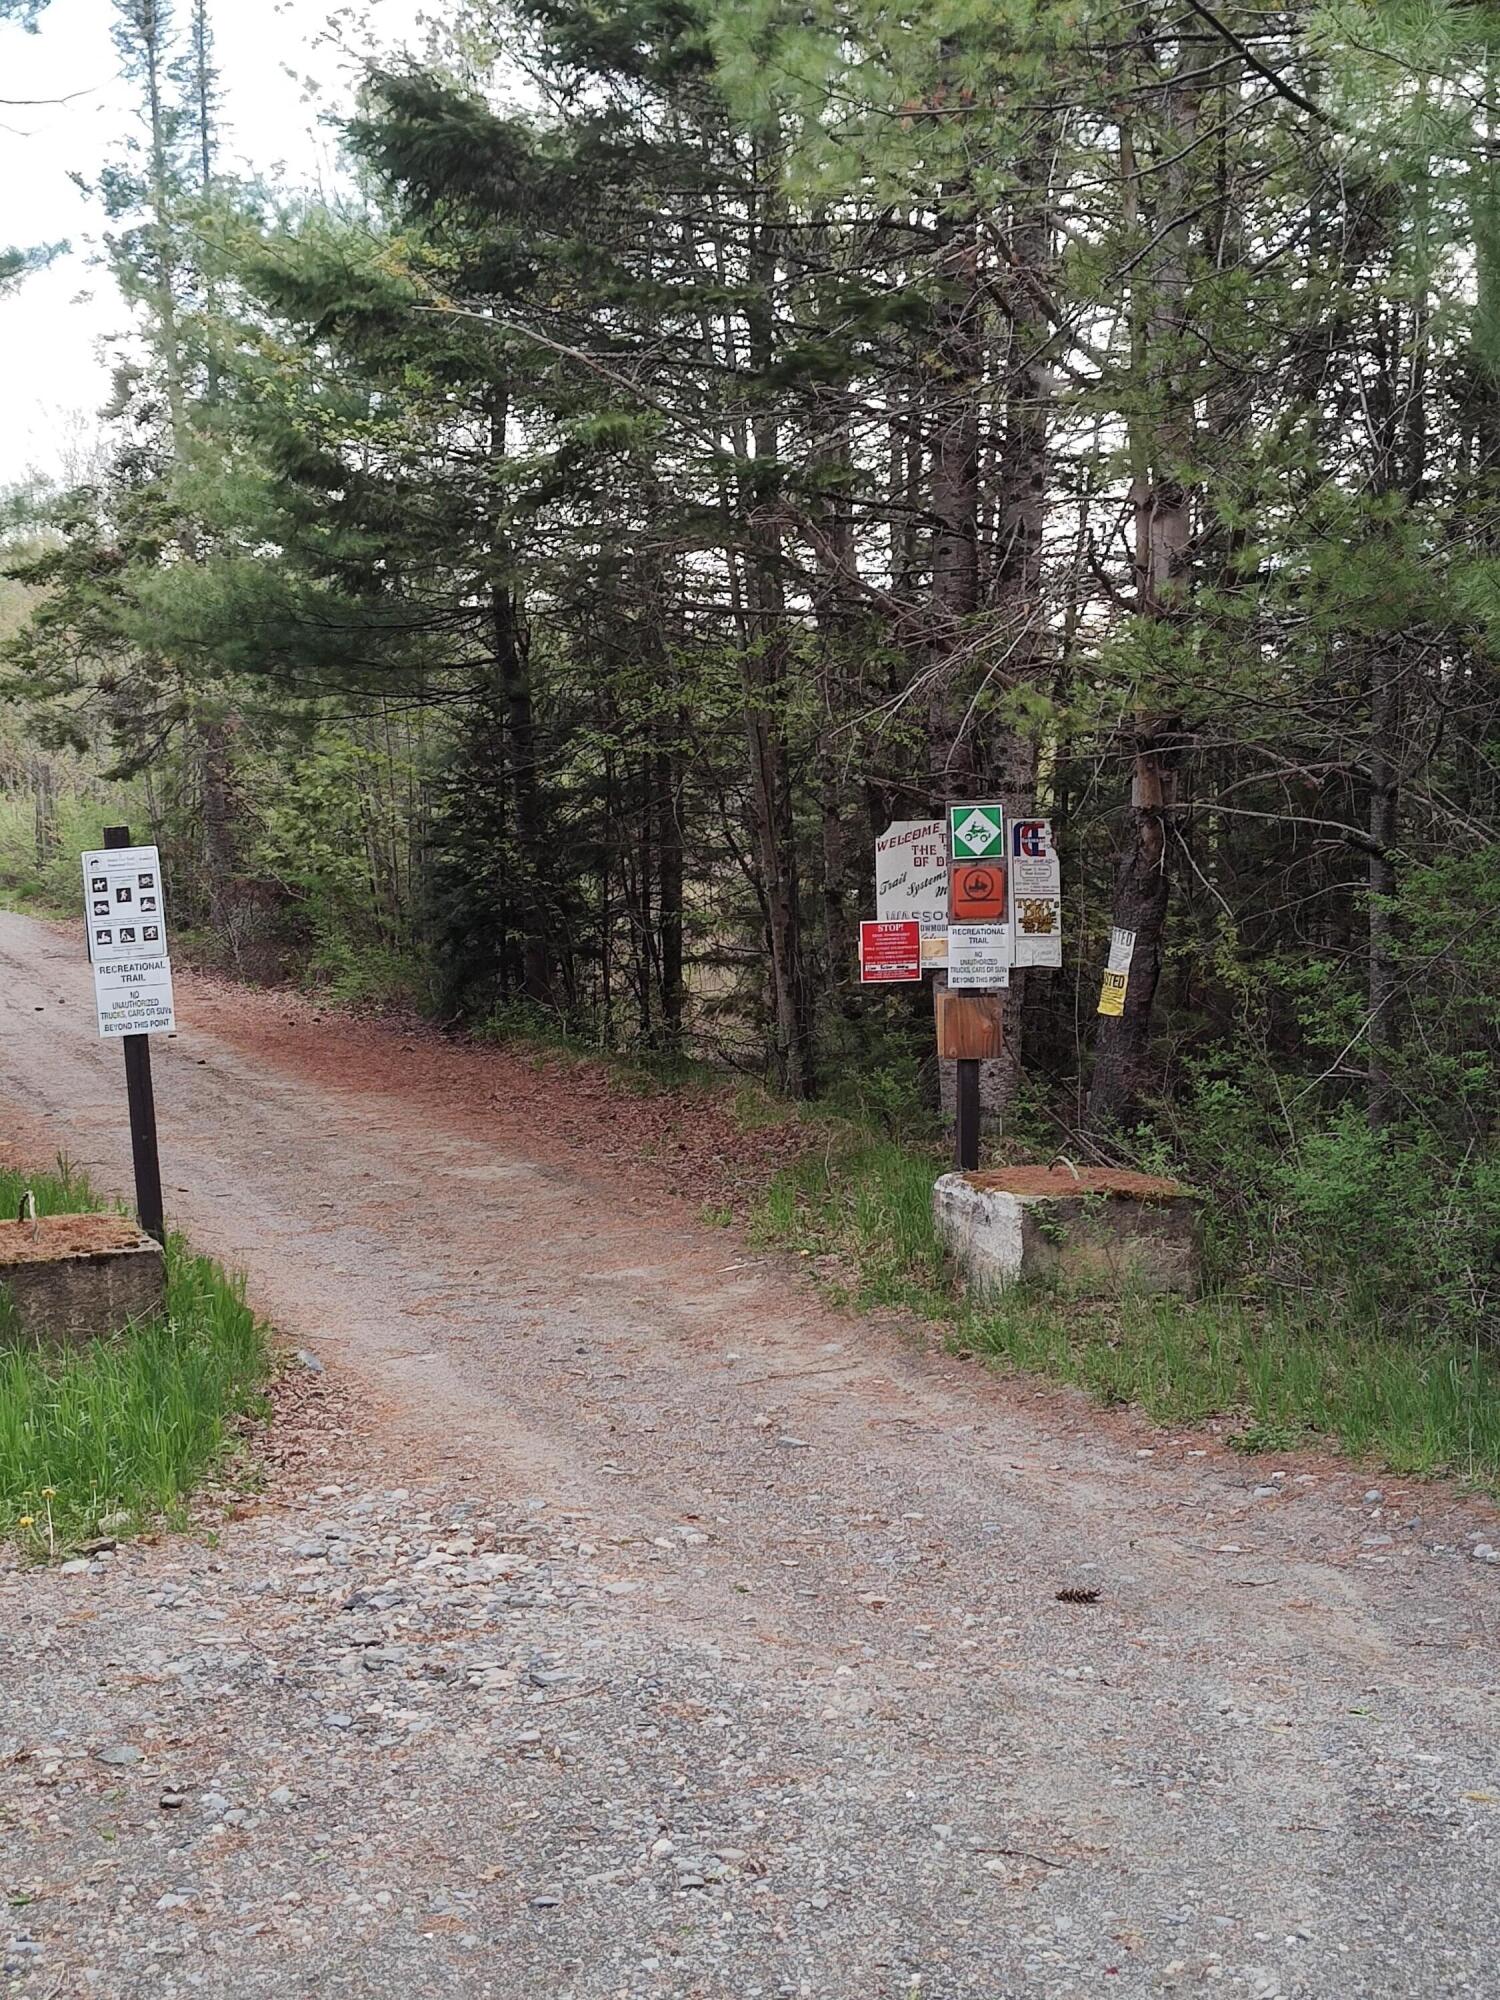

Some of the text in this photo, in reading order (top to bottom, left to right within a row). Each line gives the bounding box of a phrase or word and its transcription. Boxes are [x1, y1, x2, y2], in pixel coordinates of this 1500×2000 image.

[876, 822, 940, 852] WELCOME
[911, 845, 937, 856] THE
[913, 856, 929, 867] OF
[879, 871, 907, 895] Trail
[906, 870, 947, 898] Systems
[878, 924, 904, 932] STOP!
[952, 928, 1006, 936] RECREATIONAL
[99, 961, 166, 974] RECREATIONAL
[121, 974, 146, 984] TRAIL
[130, 990, 140, 999] NO
[112, 998, 160, 1010] UNAUTHORIZED
[128, 1009, 145, 1017] CARS
[146, 1008, 156, 1016] OR
[104, 1022, 132, 1032] BEYOND
[150, 1018, 170, 1028] POINT
